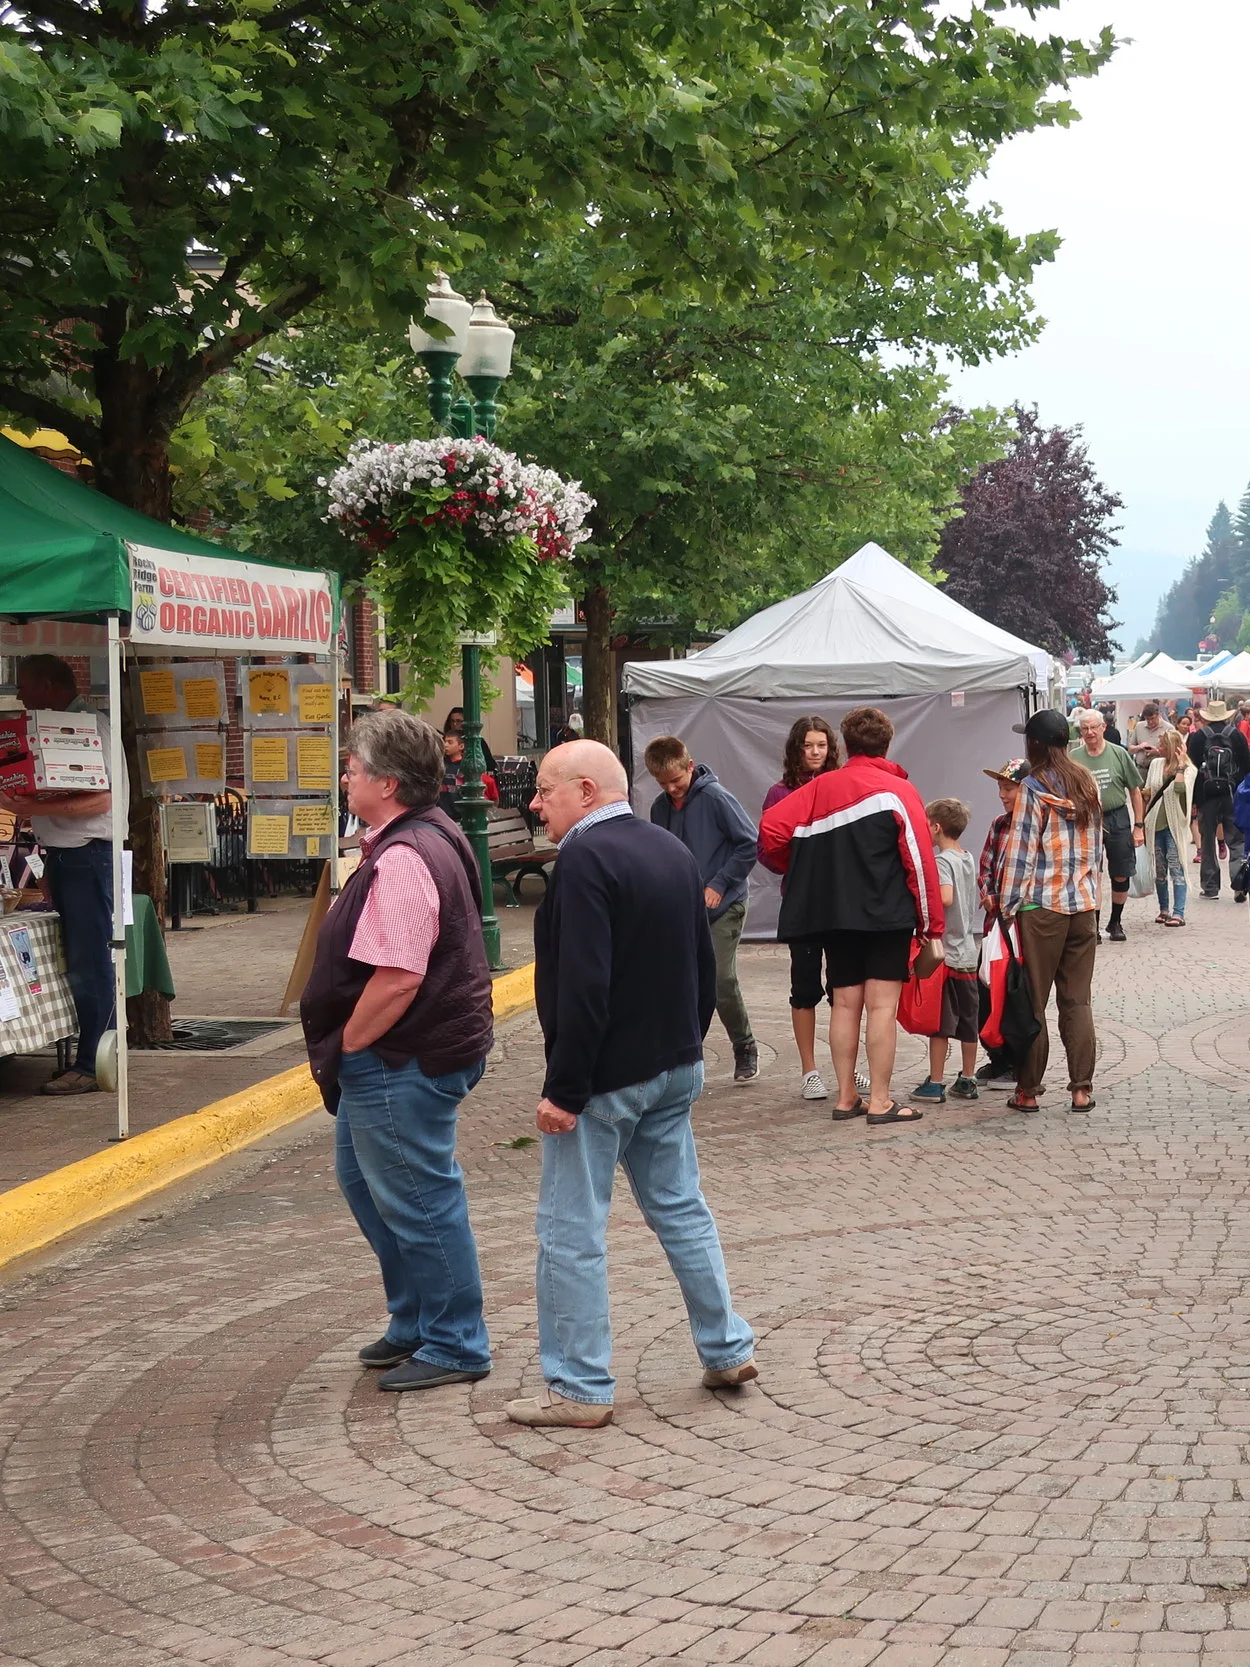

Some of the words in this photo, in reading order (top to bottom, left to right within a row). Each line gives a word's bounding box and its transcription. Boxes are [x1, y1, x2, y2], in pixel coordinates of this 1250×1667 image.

[132, 555, 156, 571] Rocky
[132, 569, 158, 583] Ridge
[134, 581, 154, 594] Farm
[158, 567, 251, 606] CERTIFIED
[159, 602, 255, 640] ORGANIC
[250, 580, 332, 644] GARLIC
